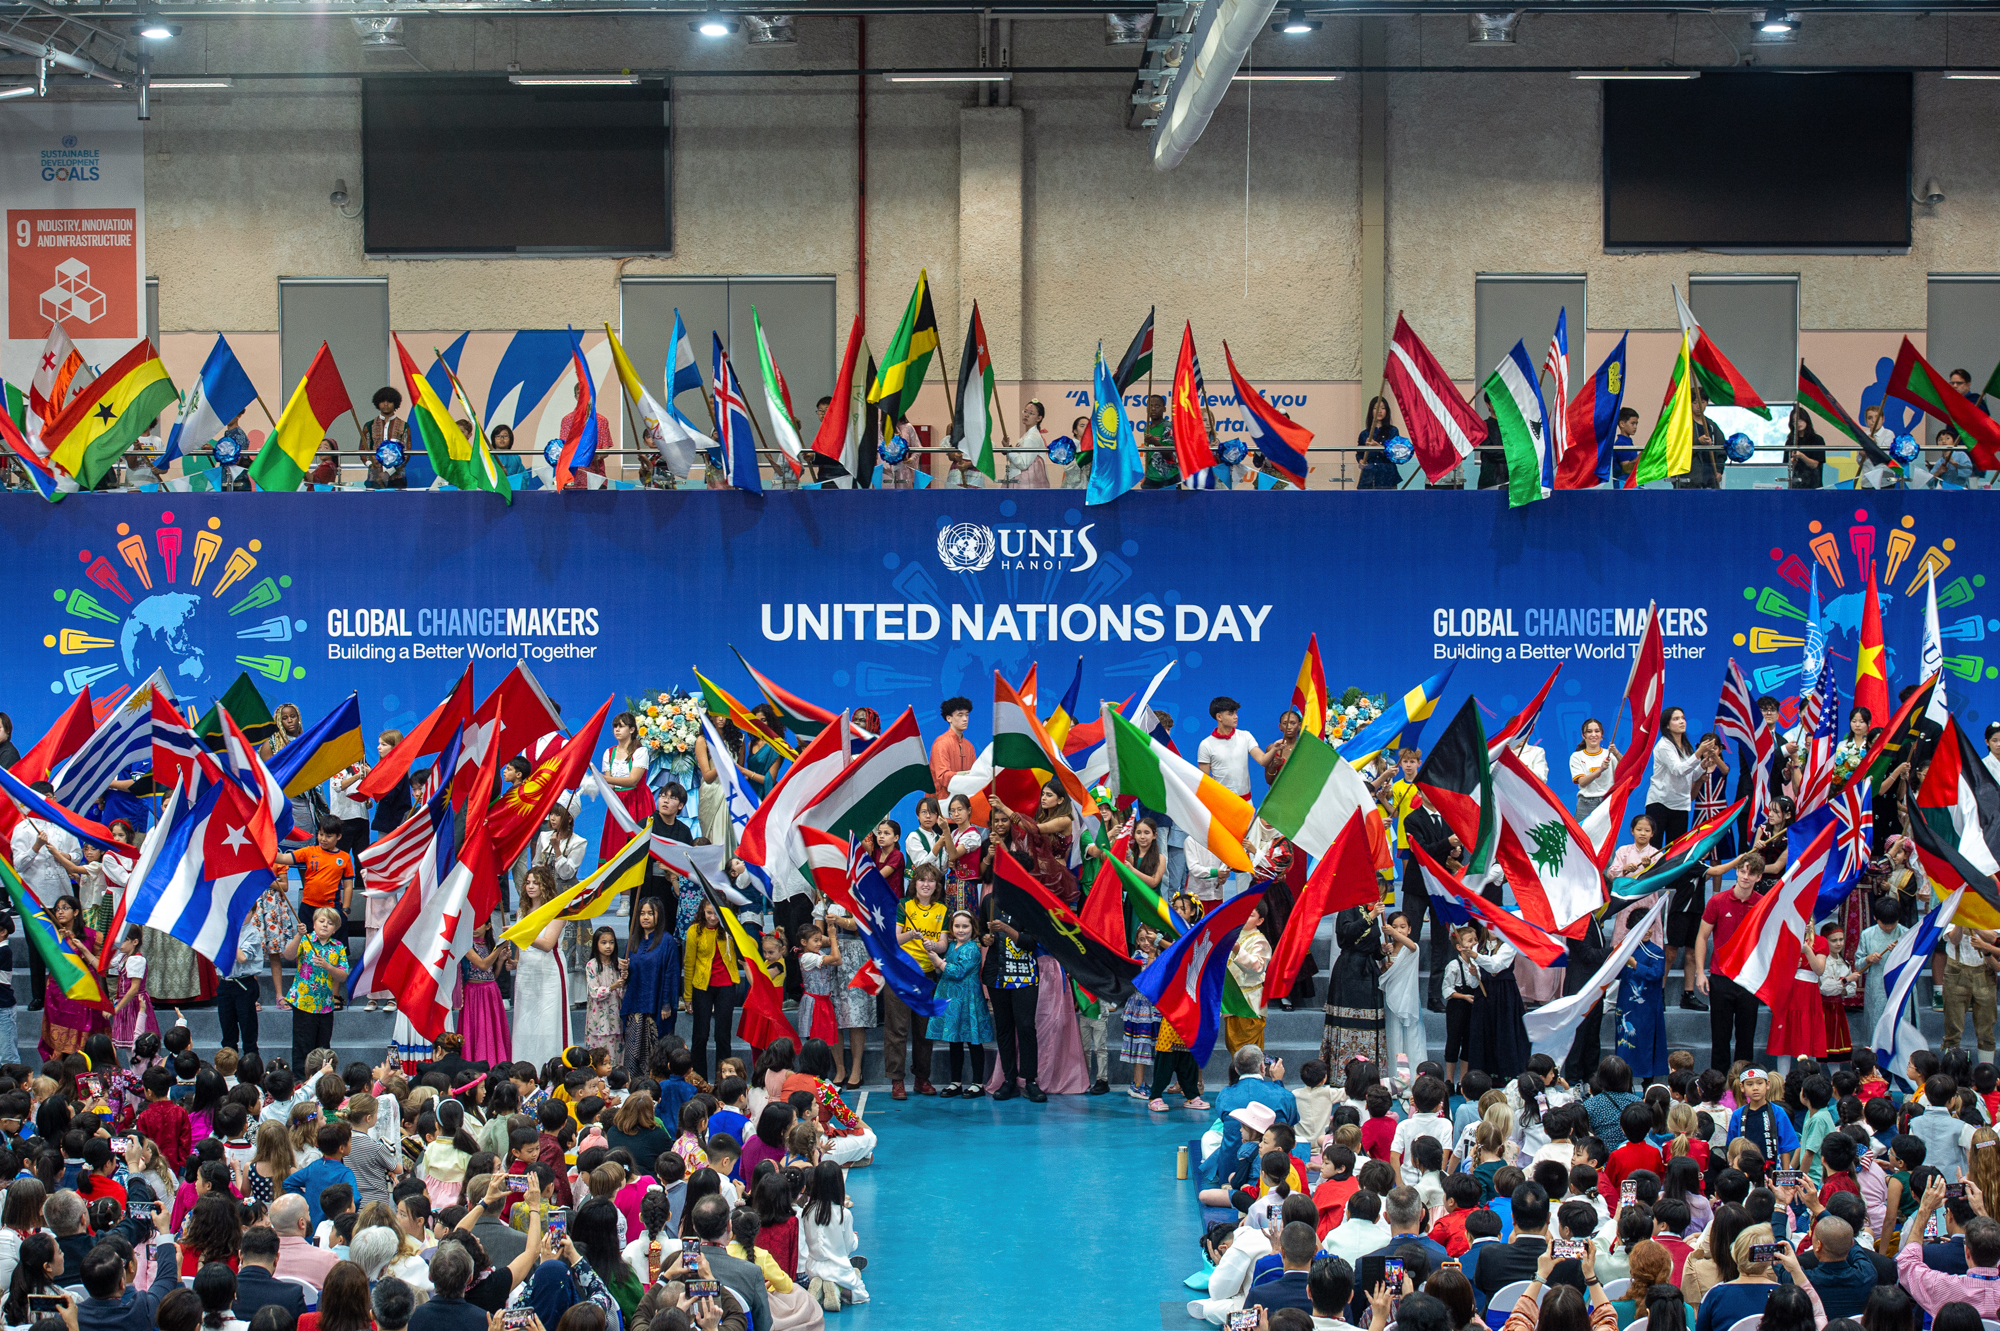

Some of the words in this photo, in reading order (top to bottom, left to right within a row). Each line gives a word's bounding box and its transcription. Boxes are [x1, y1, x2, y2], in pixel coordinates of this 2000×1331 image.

[41, 150, 99, 158] SUSTAINABLE
[41, 167, 100, 181] GOALS
[16, 219, 31, 247] 9
[37, 219, 81, 232] INDUSTRY,
[82, 219, 133, 231] INNOVATION
[37, 235, 56, 247] AND
[57, 234, 132, 247] INFRASTRUCTURE
[1271, 395, 1307, 408] you
[997, 523, 1098, 572] UNIS
[1001, 560, 1062, 570] HANOI
[327, 608, 412, 637] GLOBAL
[418, 608, 600, 637] CHANGEMAKERS
[761, 603, 940, 641] UNITED
[952, 603, 1165, 641] NATIONS
[1177, 604, 1273, 642] DAY
[1433, 608, 1519, 637] GLOBAL
[328, 643, 396, 663] Building
[399, 647, 410, 659] a
[413, 643, 464, 659] Better
[467, 643, 517, 659] World
[520, 642, 597, 663] Together
[1433, 643, 1502, 663] Building
[1506, 647, 1516, 659] a
[1520, 643, 1571, 659] Better
[1574, 643, 1625, 659] World
[1628, 643, 1706, 659] Tether
[310, 860, 319, 871] 11
